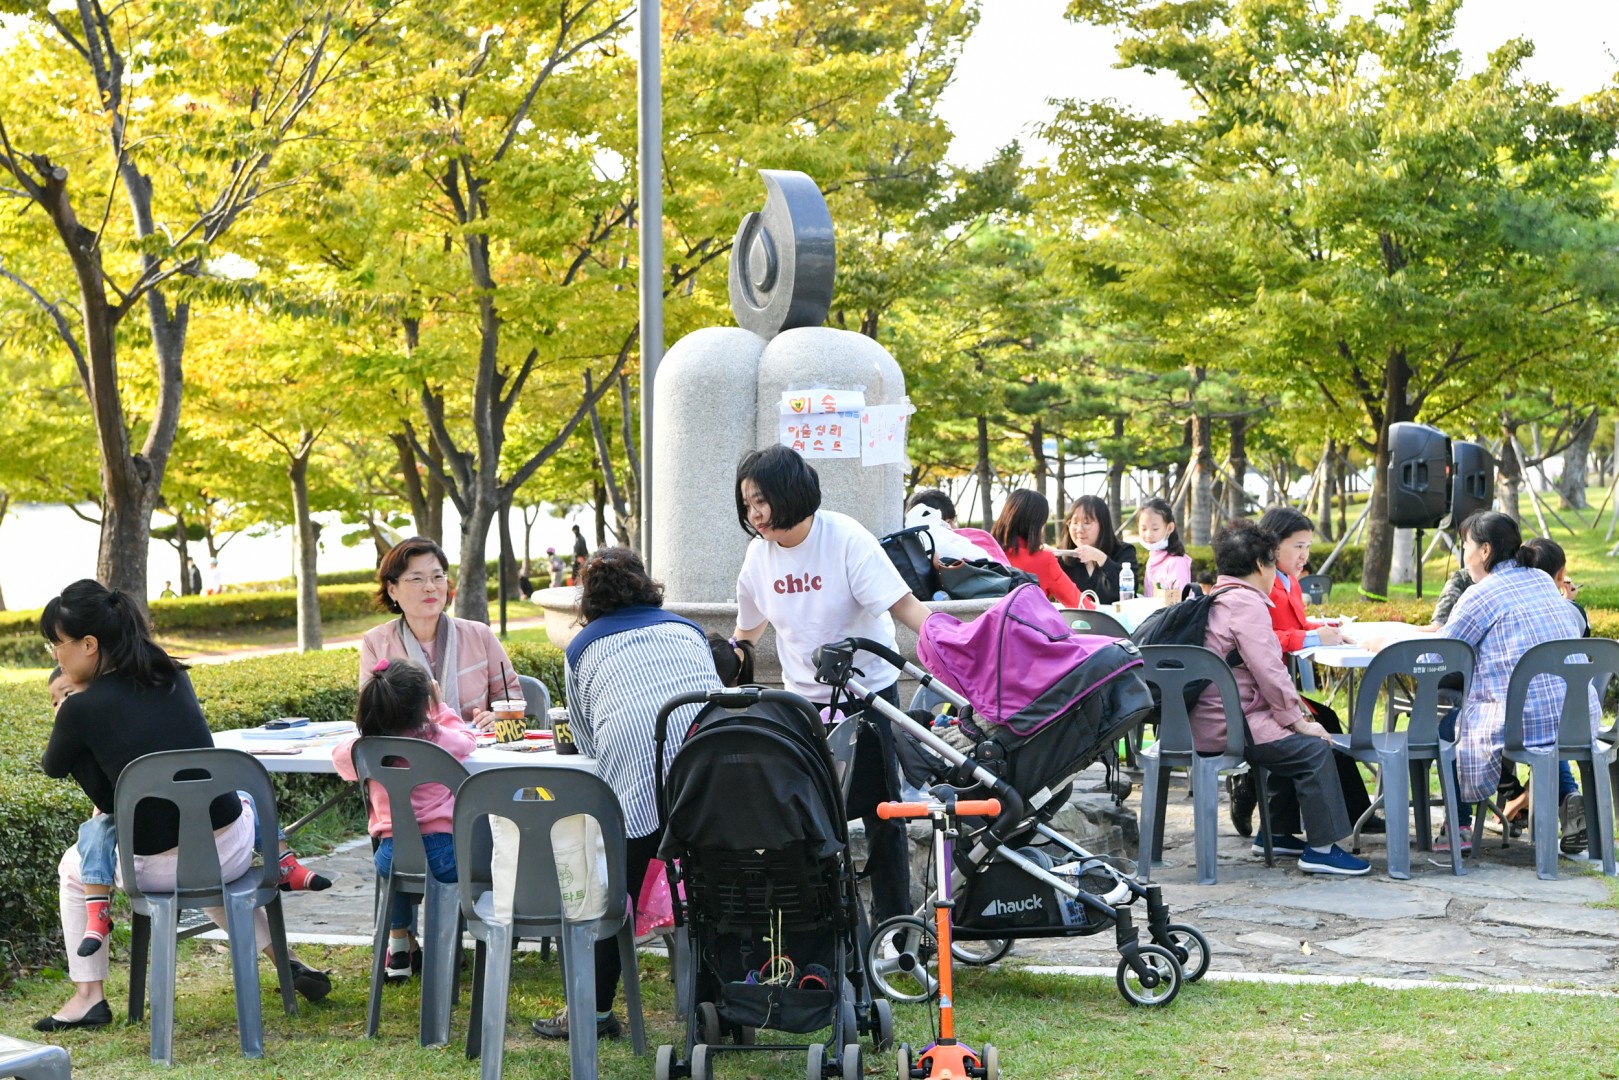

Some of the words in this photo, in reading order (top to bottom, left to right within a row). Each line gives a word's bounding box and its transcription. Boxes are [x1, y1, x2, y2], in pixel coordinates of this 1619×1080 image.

[788, 423, 842, 439] 미술심리
[792, 440, 842, 452] 테스트
[773, 572, 822, 594] ch!c
[998, 894, 1043, 915] hauck
